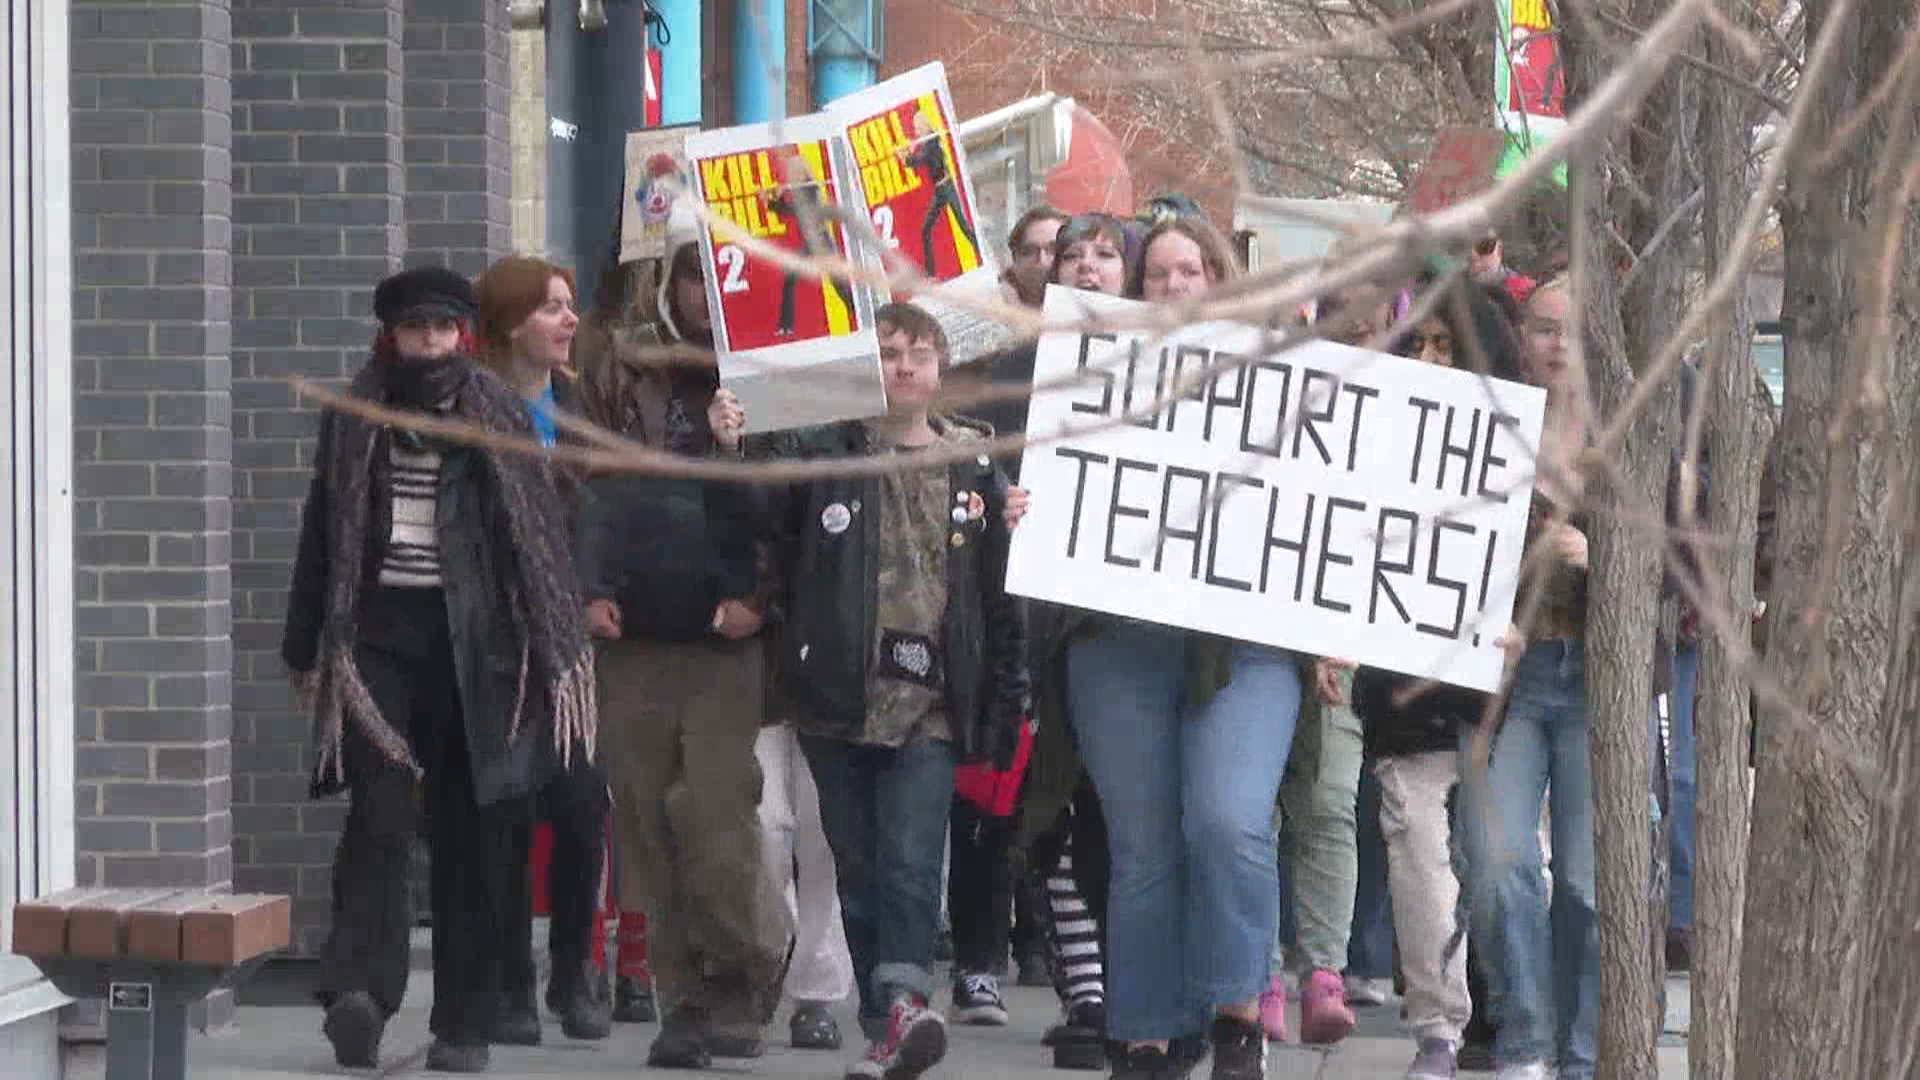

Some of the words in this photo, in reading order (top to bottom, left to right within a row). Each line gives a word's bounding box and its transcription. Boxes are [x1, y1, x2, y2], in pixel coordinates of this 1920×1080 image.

[849, 113, 907, 161] KILL
[701, 152, 778, 199] KILL
[861, 152, 922, 206] BILL
[873, 206, 899, 248] 2
[718, 244, 749, 293] 2
[1072, 334, 1379, 472] SUPPORT
[1408, 397, 1521, 503] THE
[1055, 446, 1497, 647] TEACHERS!
